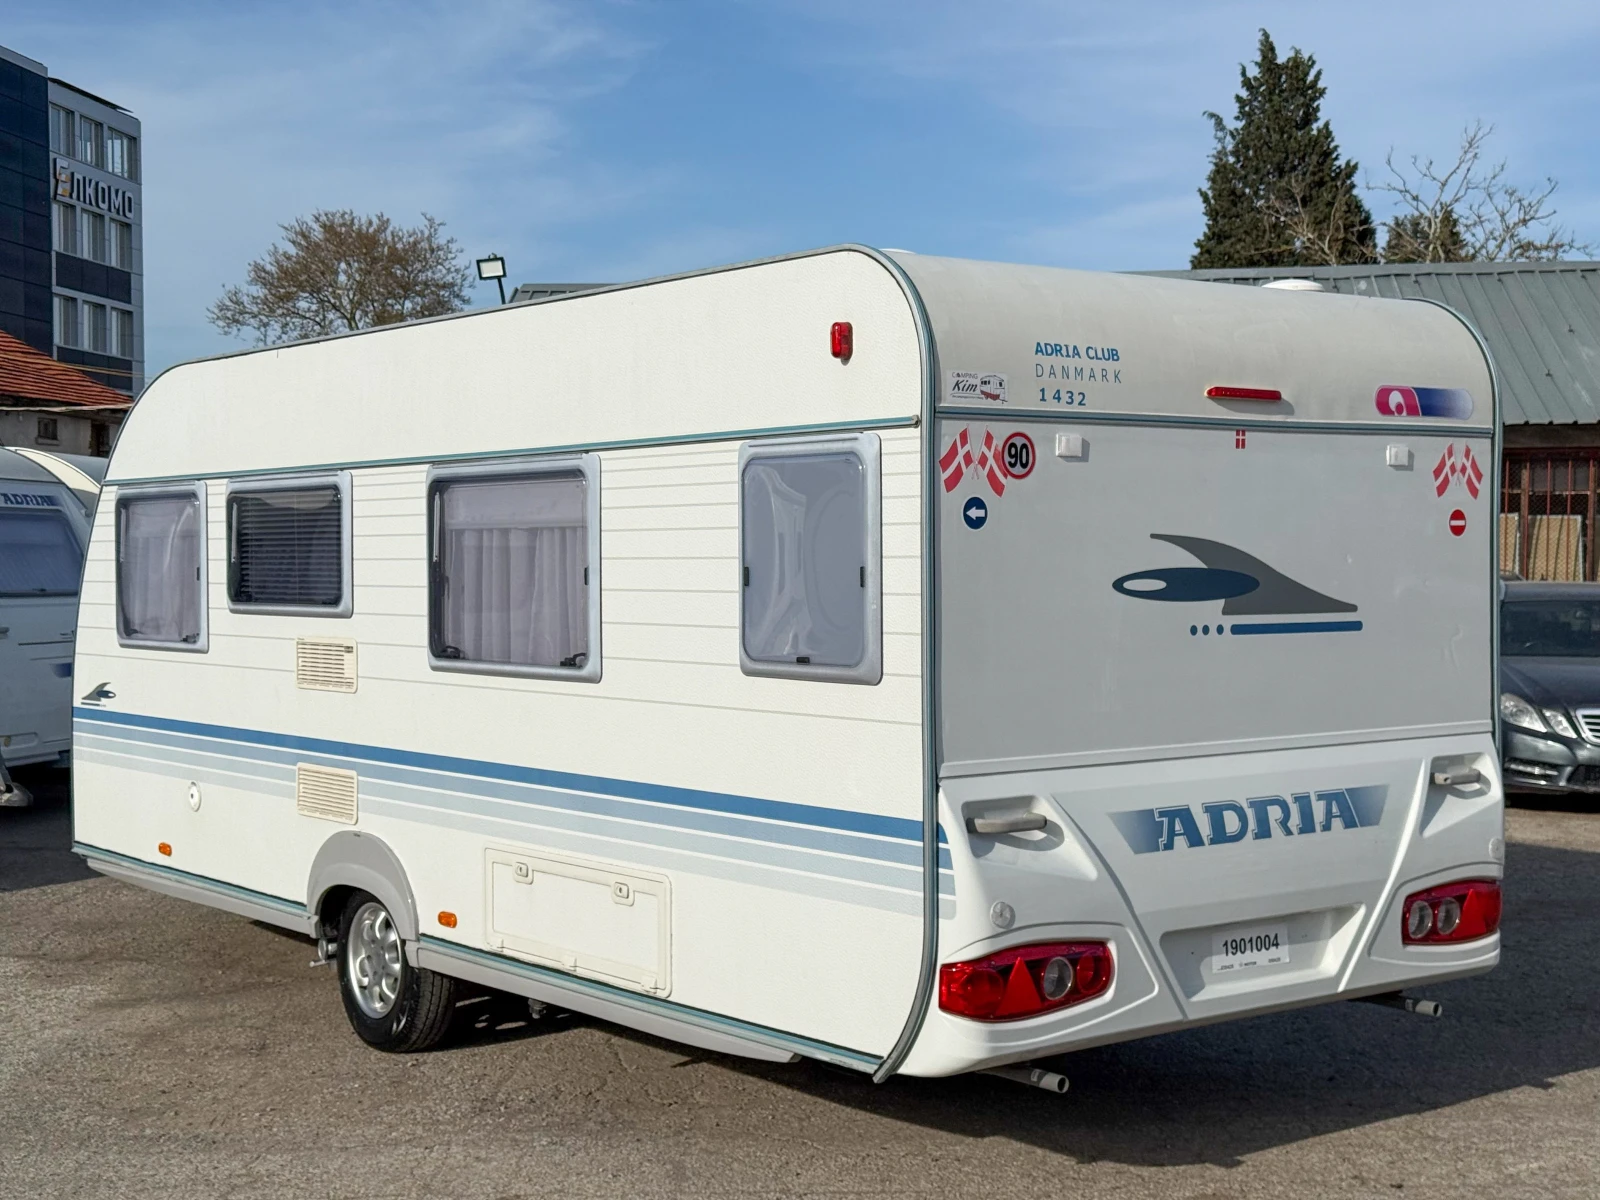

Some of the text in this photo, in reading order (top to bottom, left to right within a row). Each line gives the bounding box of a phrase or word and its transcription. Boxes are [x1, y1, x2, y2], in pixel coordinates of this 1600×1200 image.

[1035, 342, 1120, 362] ADRIA CLUB
[1034, 363, 1122, 384] DANMARK
[951, 379, 979, 393] Kim
[1039, 387, 1086, 406] 1432
[1007, 442, 1031, 470] 90
[0, 493, 49, 506] ADRIA
[1154, 789, 1359, 852] ADRIA
[1222, 933, 1280, 956] 1901004
